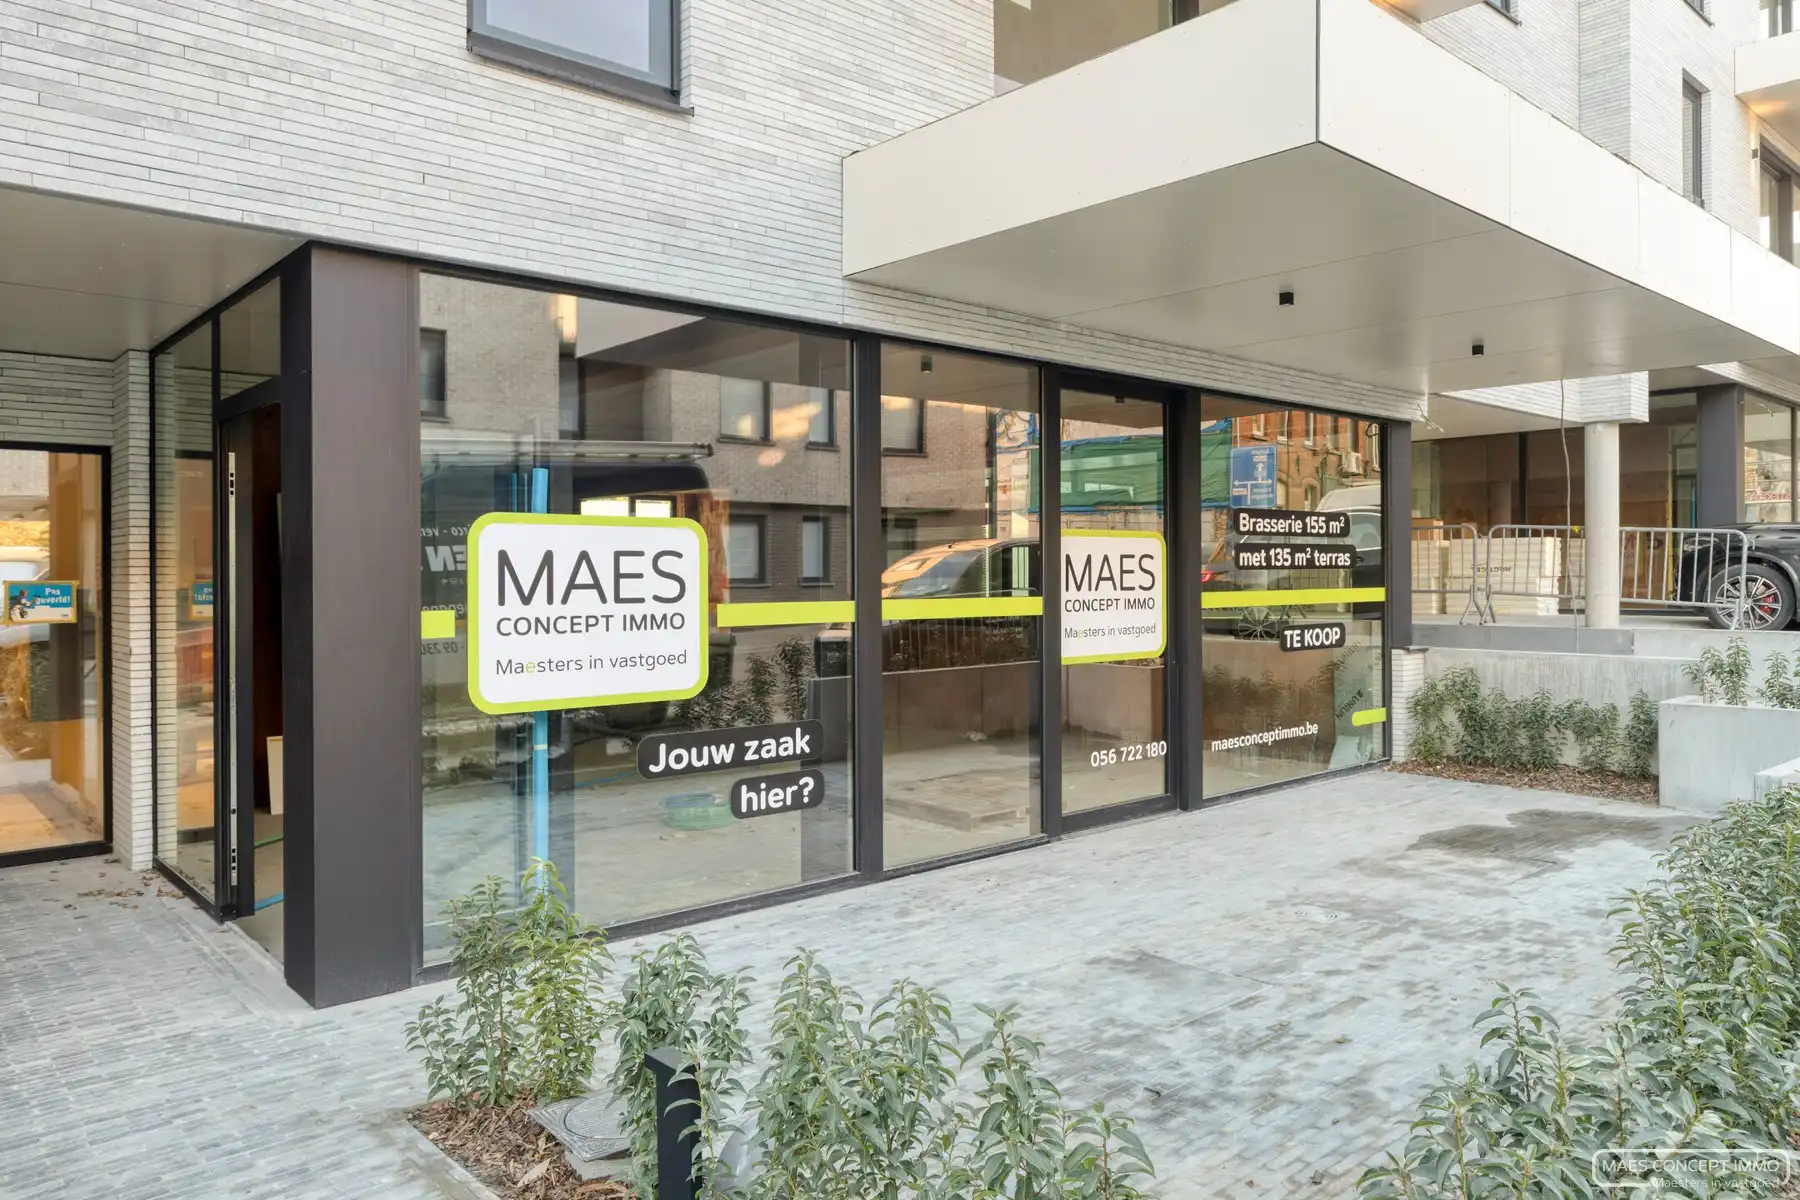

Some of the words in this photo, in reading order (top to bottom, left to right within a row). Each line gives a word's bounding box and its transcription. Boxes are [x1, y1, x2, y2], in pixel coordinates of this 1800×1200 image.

[1239, 513, 1303, 533] Brasserie
[1305, 516, 1327, 534] 155
[1239, 549, 1267, 567] met
[1269, 548, 1292, 567] 135
[1313, 550, 1351, 567] terras
[497, 549, 687, 607] MAES
[1065, 553, 1156, 592] MAES
[1064, 598, 1121, 612] CONCEPT
[1124, 597, 1155, 610] IMMO
[496, 614, 615, 636] CONCEPT
[622, 612, 686, 631] IMMO
[1064, 626, 1106, 639] Maesters
[1108, 624, 1116, 636] in
[1117, 623, 1156, 639] vastgoed
[1284, 630, 1302, 648] TE
[1304, 626, 1341, 646] KOOP
[496, 657, 583, 675] Maesters
[589, 651, 604, 670] in
[609, 649, 688, 672] vastgoed
[649, 742, 735, 772] Jouw
[744, 727, 811, 761] zaak
[1211, 722, 1319, 752] maesconceptimmo.be
[1090, 749, 1117, 767] 056
[1120, 745, 1143, 762] 722
[1146, 740, 1168, 758] 180
[740, 776, 815, 813] hier?
